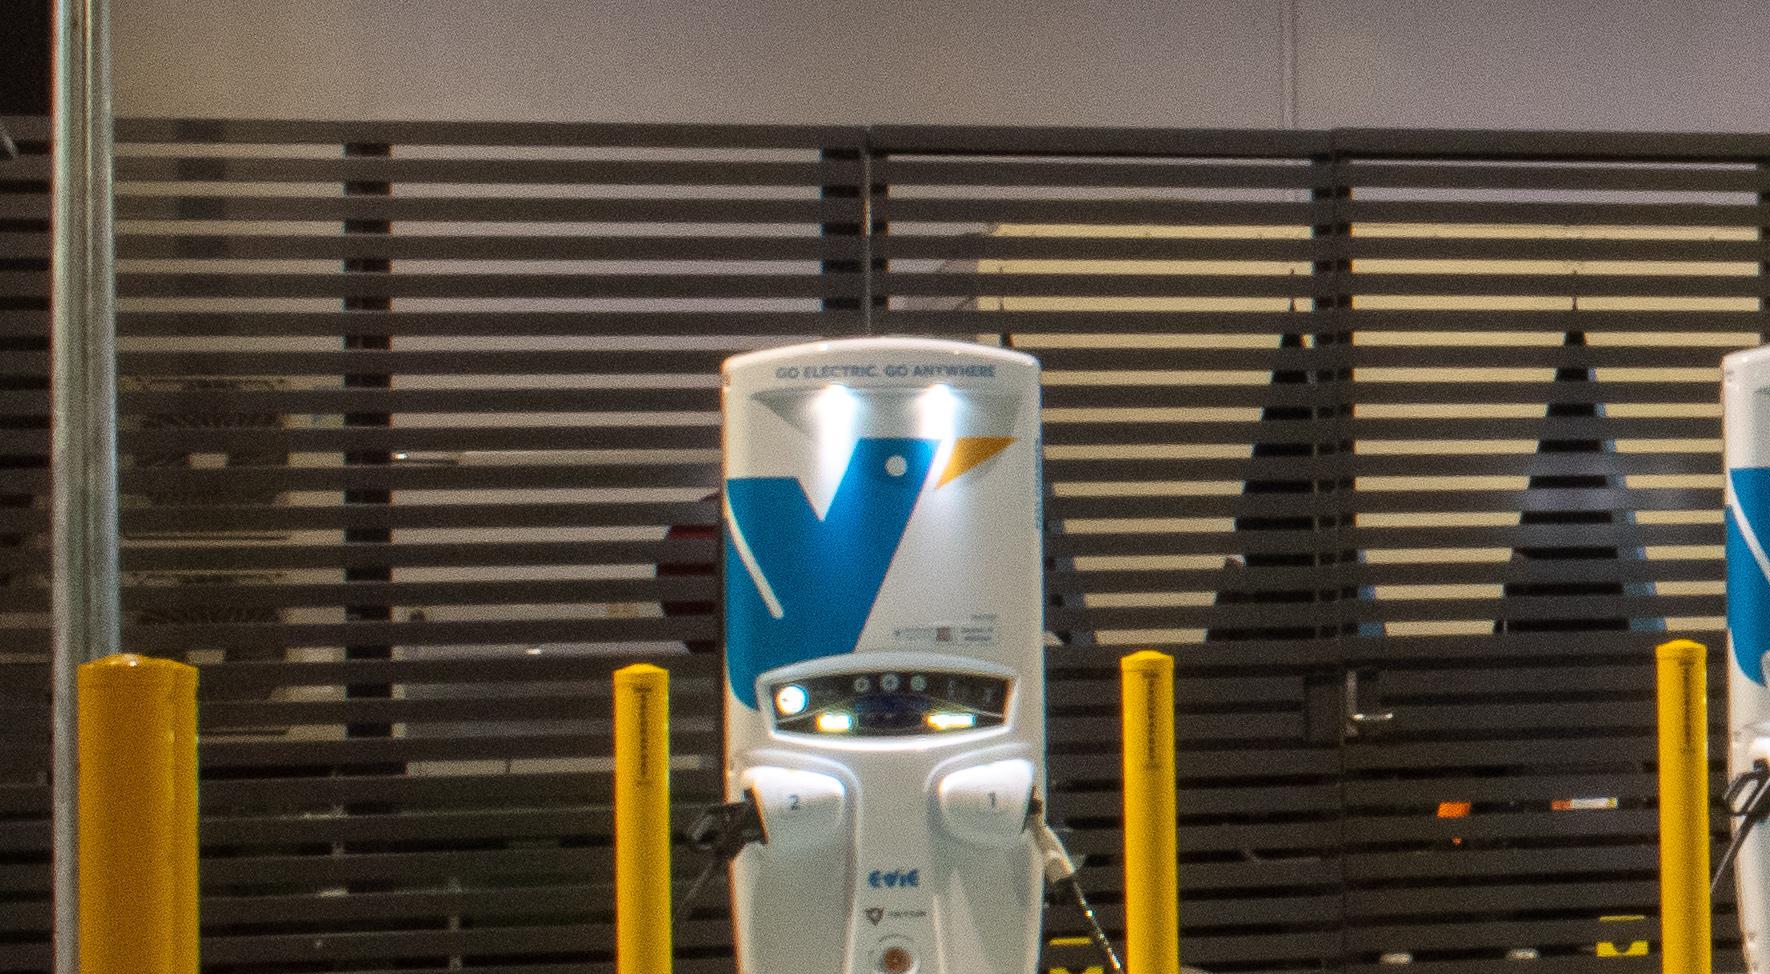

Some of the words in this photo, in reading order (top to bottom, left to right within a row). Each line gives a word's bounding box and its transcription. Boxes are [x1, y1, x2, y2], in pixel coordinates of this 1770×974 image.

[775, 366, 800, 379] GO
[883, 365, 908, 378] GO
[913, 364, 996, 378] ANYWHERE
[788, 794, 800, 810] 2
